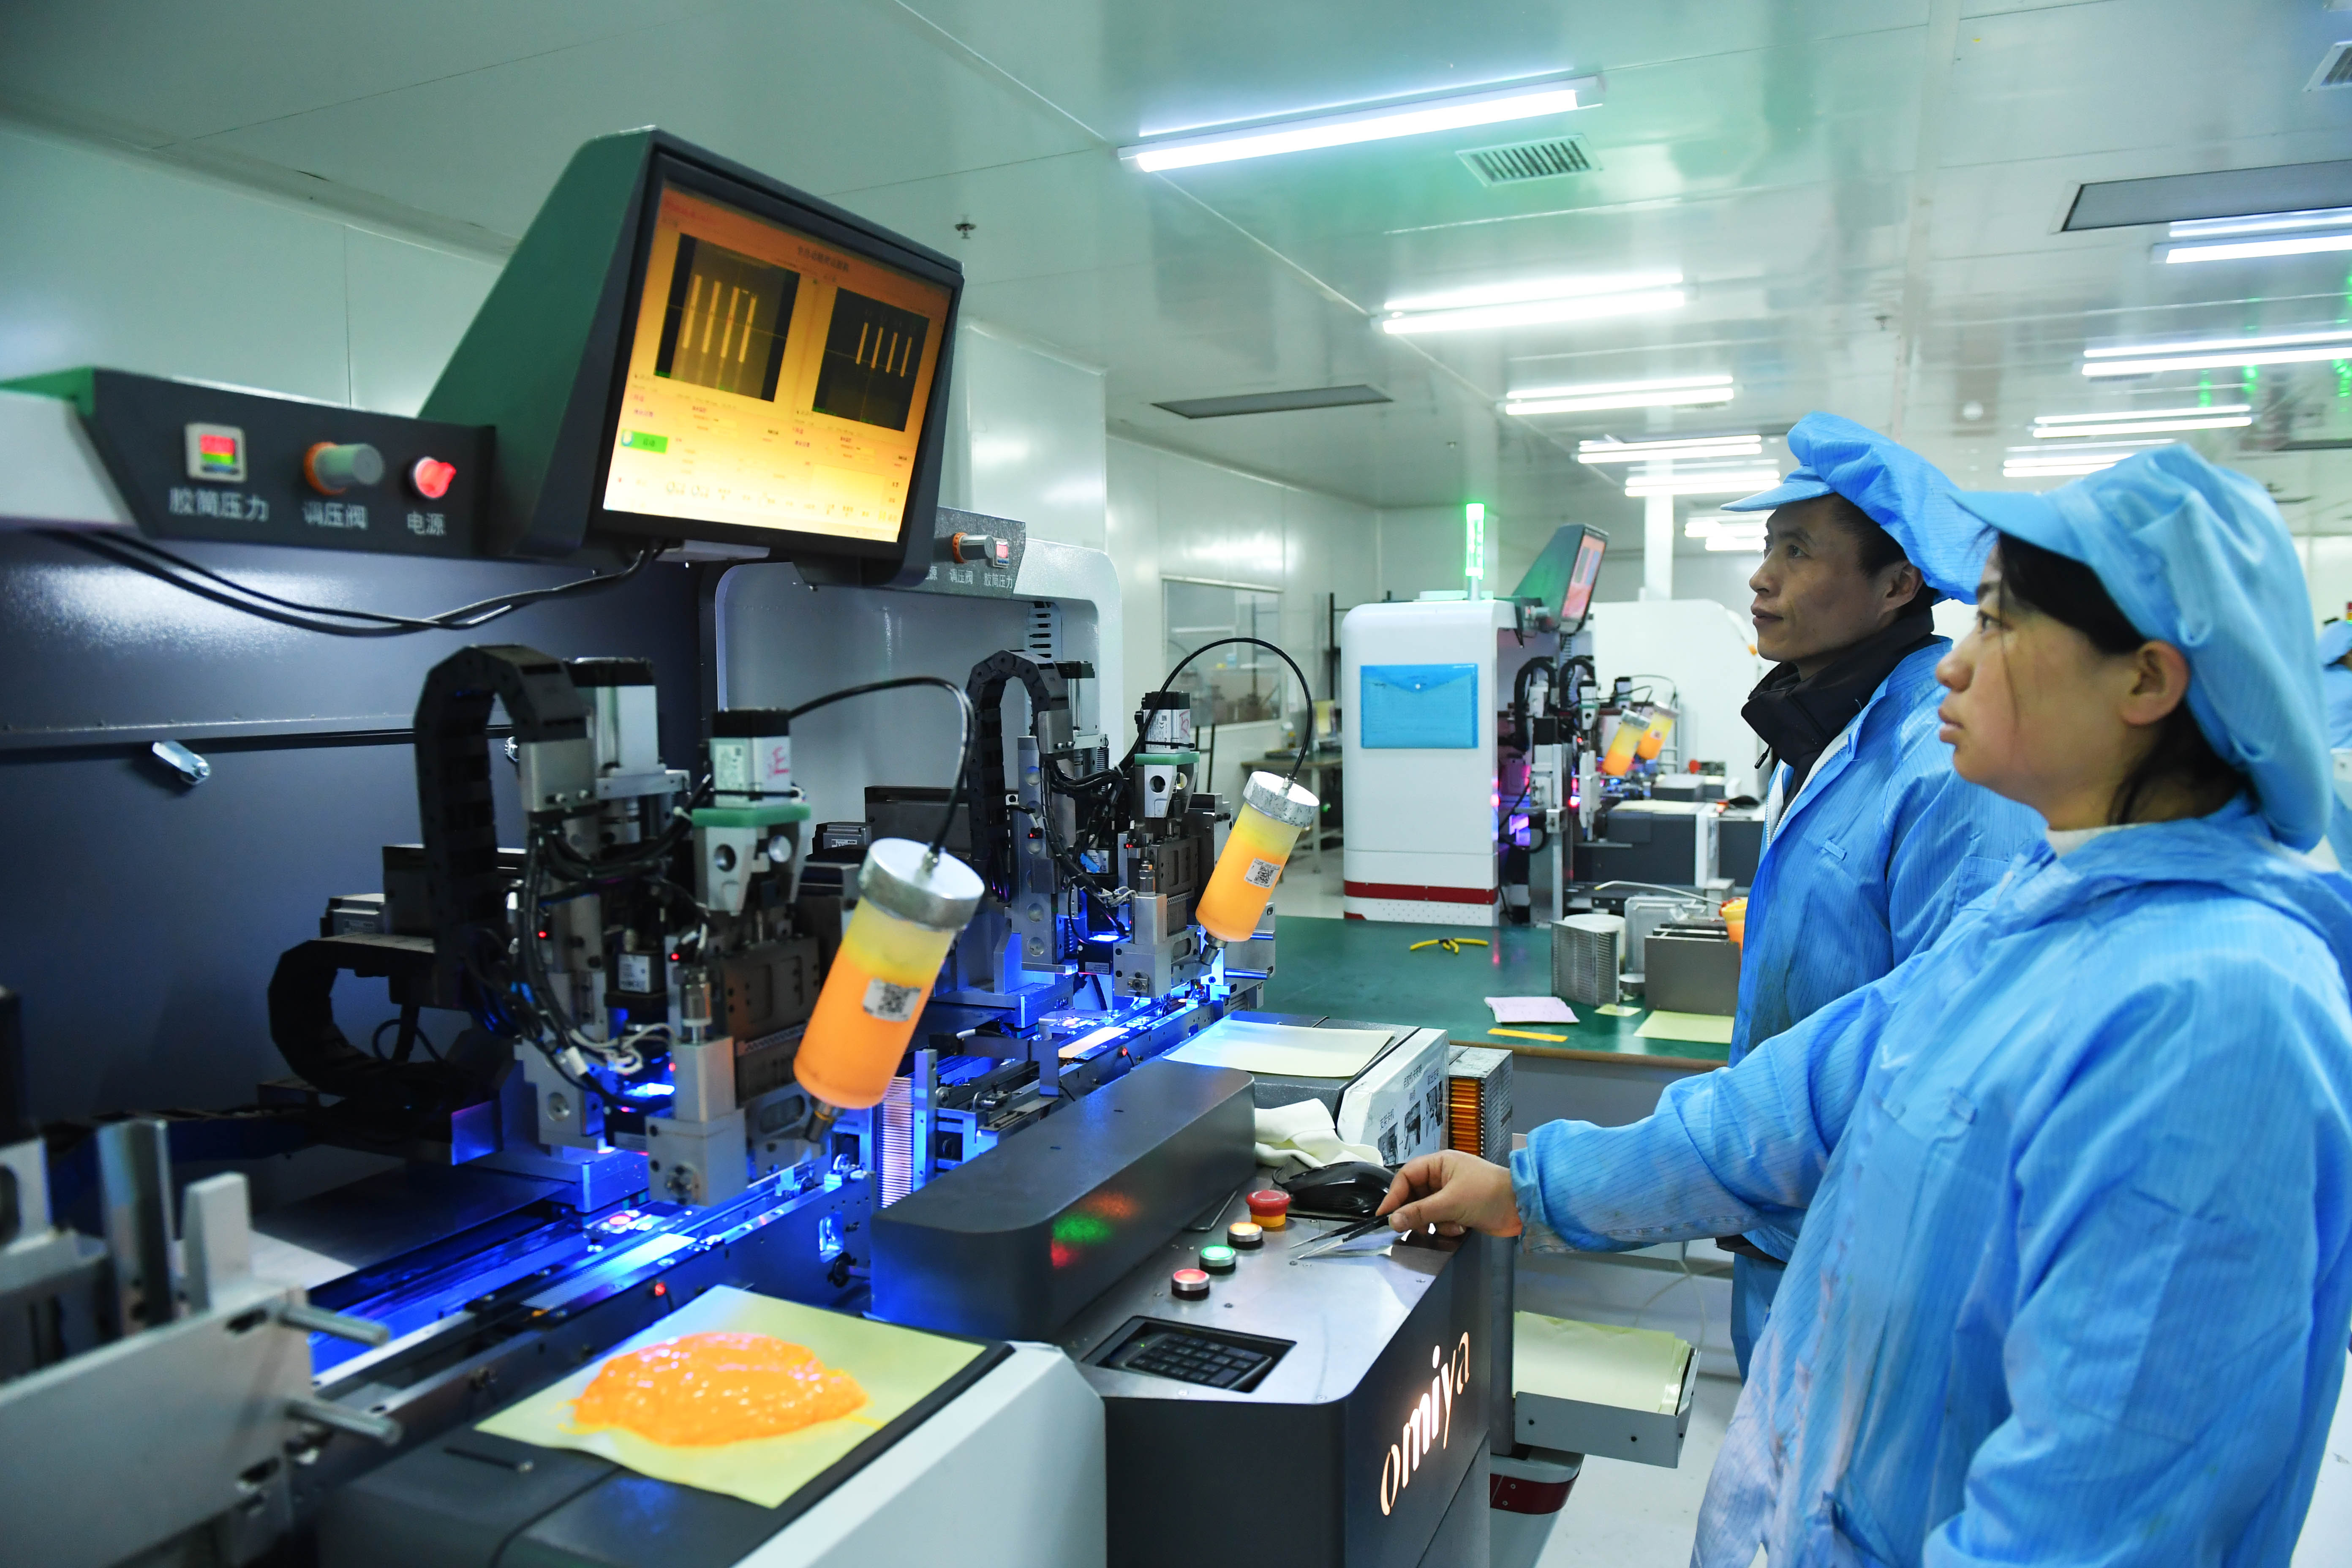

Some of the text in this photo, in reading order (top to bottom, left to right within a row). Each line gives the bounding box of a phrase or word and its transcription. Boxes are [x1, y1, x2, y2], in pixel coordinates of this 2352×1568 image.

[169, 488, 269, 523] 胶筒压力
[302, 501, 368, 530] 调压阀
[407, 511, 447, 536] 电源
[925, 566, 937, 580] 源
[950, 568, 973, 585] 调压阀
[984, 573, 1013, 589] 胶筒压力
[1378, 1331, 1470, 1516] omiya
